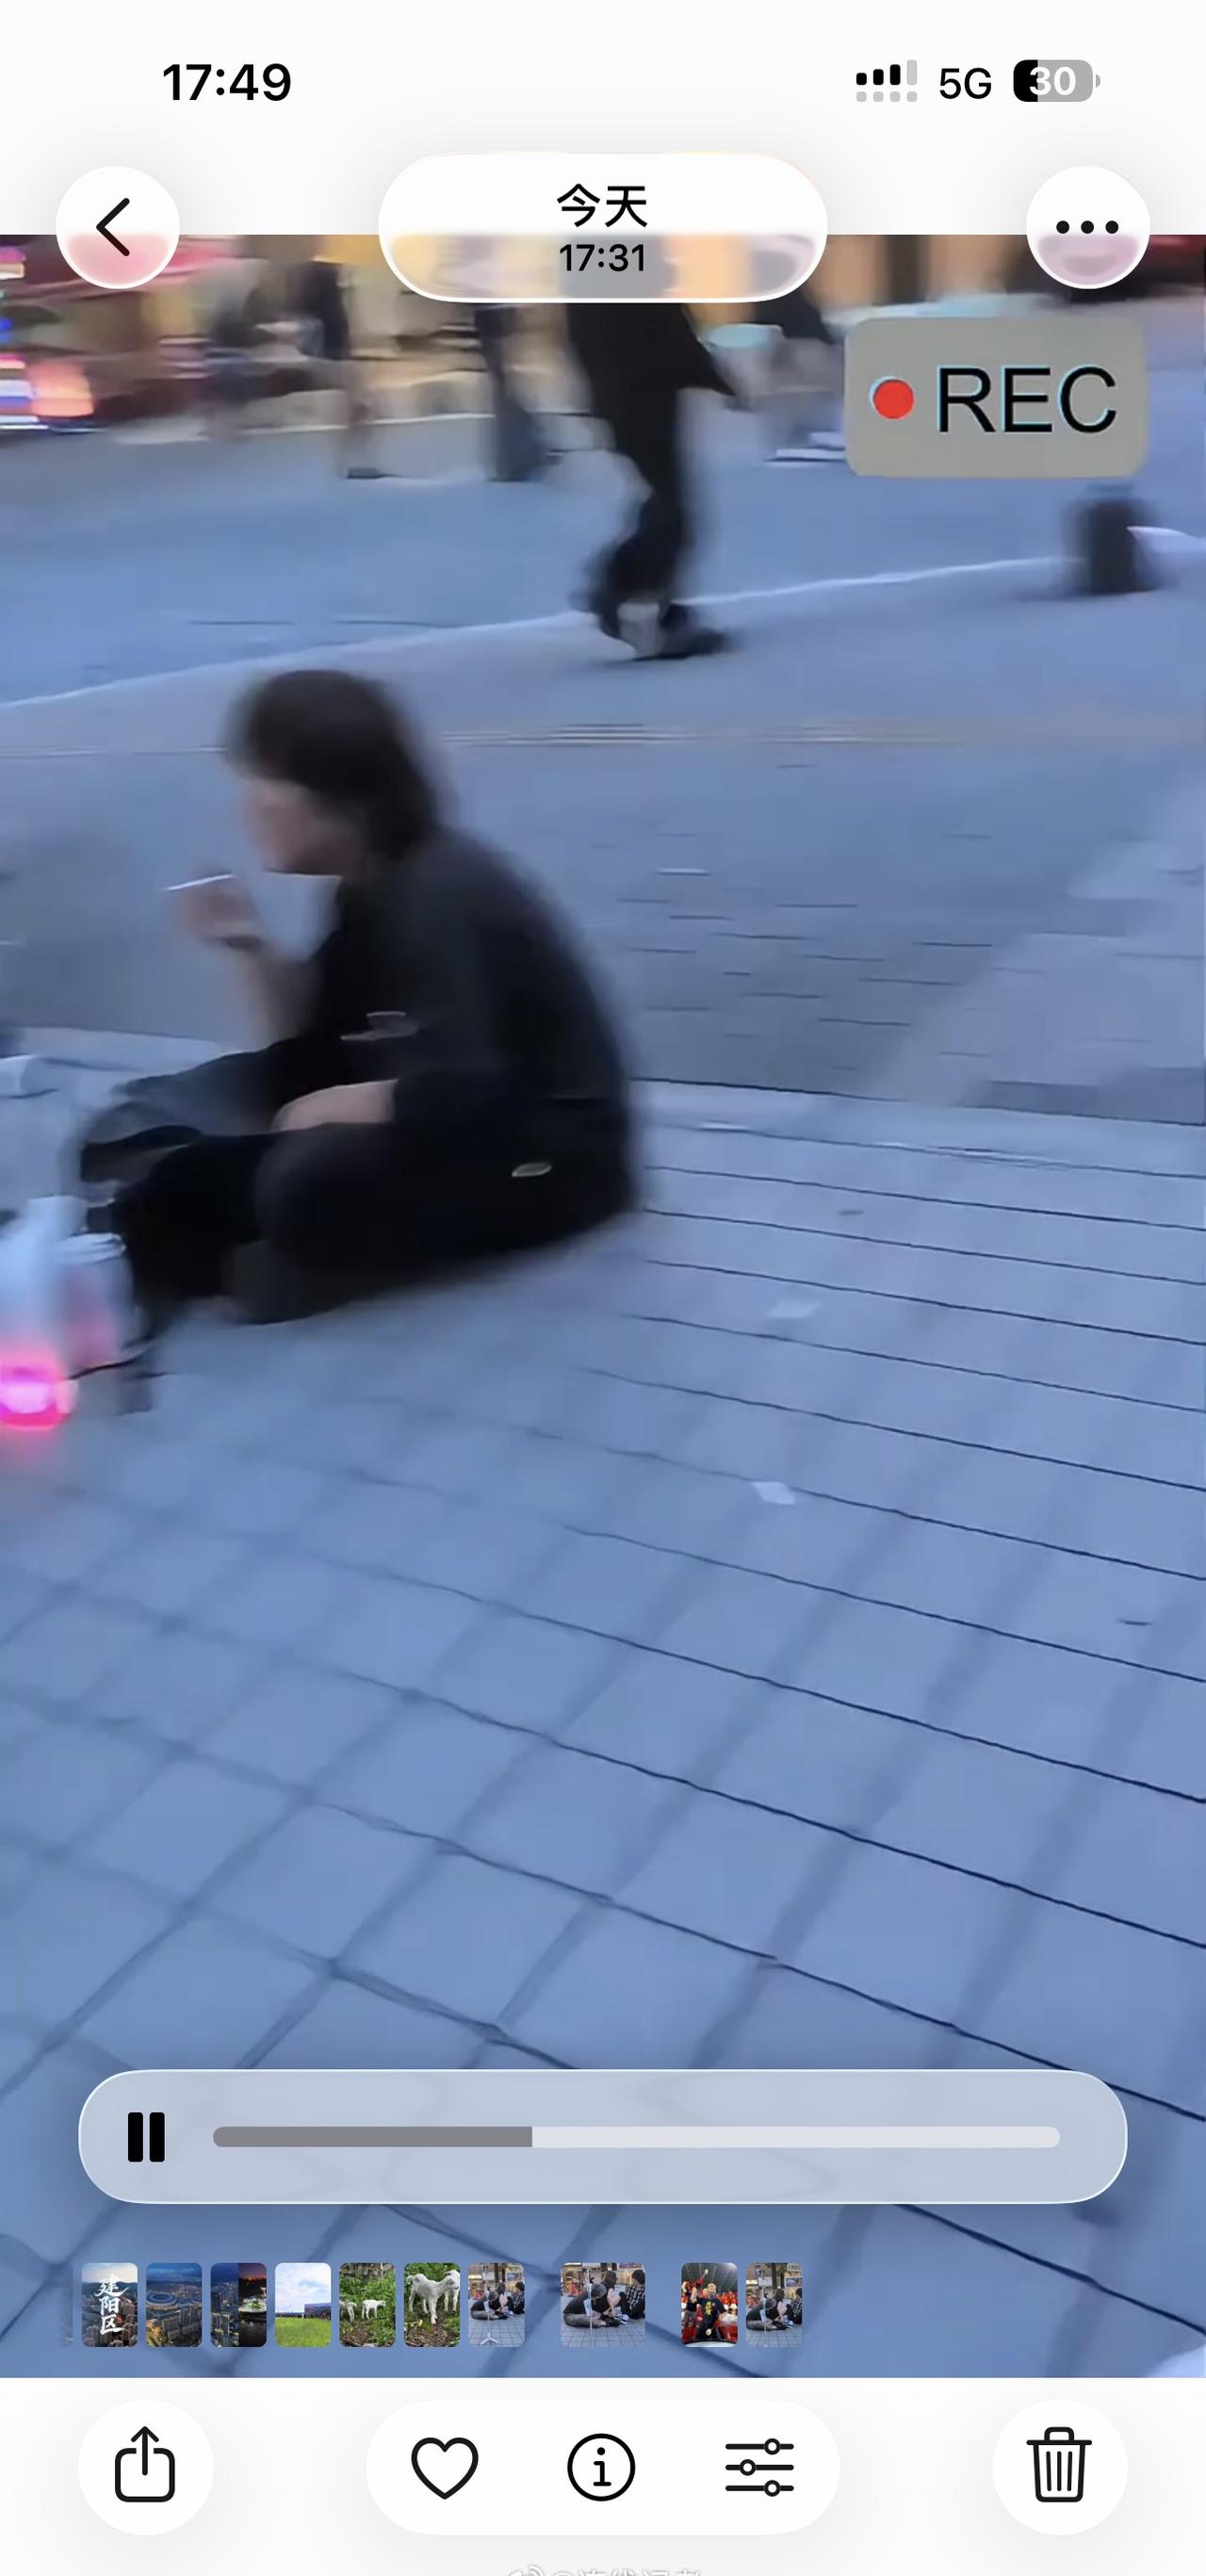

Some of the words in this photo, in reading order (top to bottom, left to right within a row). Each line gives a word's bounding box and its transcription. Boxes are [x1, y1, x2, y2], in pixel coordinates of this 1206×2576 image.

[163, 63, 291, 102] 17:49
[939, 67, 992, 100] 5G
[1029, 66, 1077, 96] 30
[556, 183, 648, 228] 今天
[559, 243, 645, 272] 17:31
[94, 2274, 129, 2336] 建阳区
